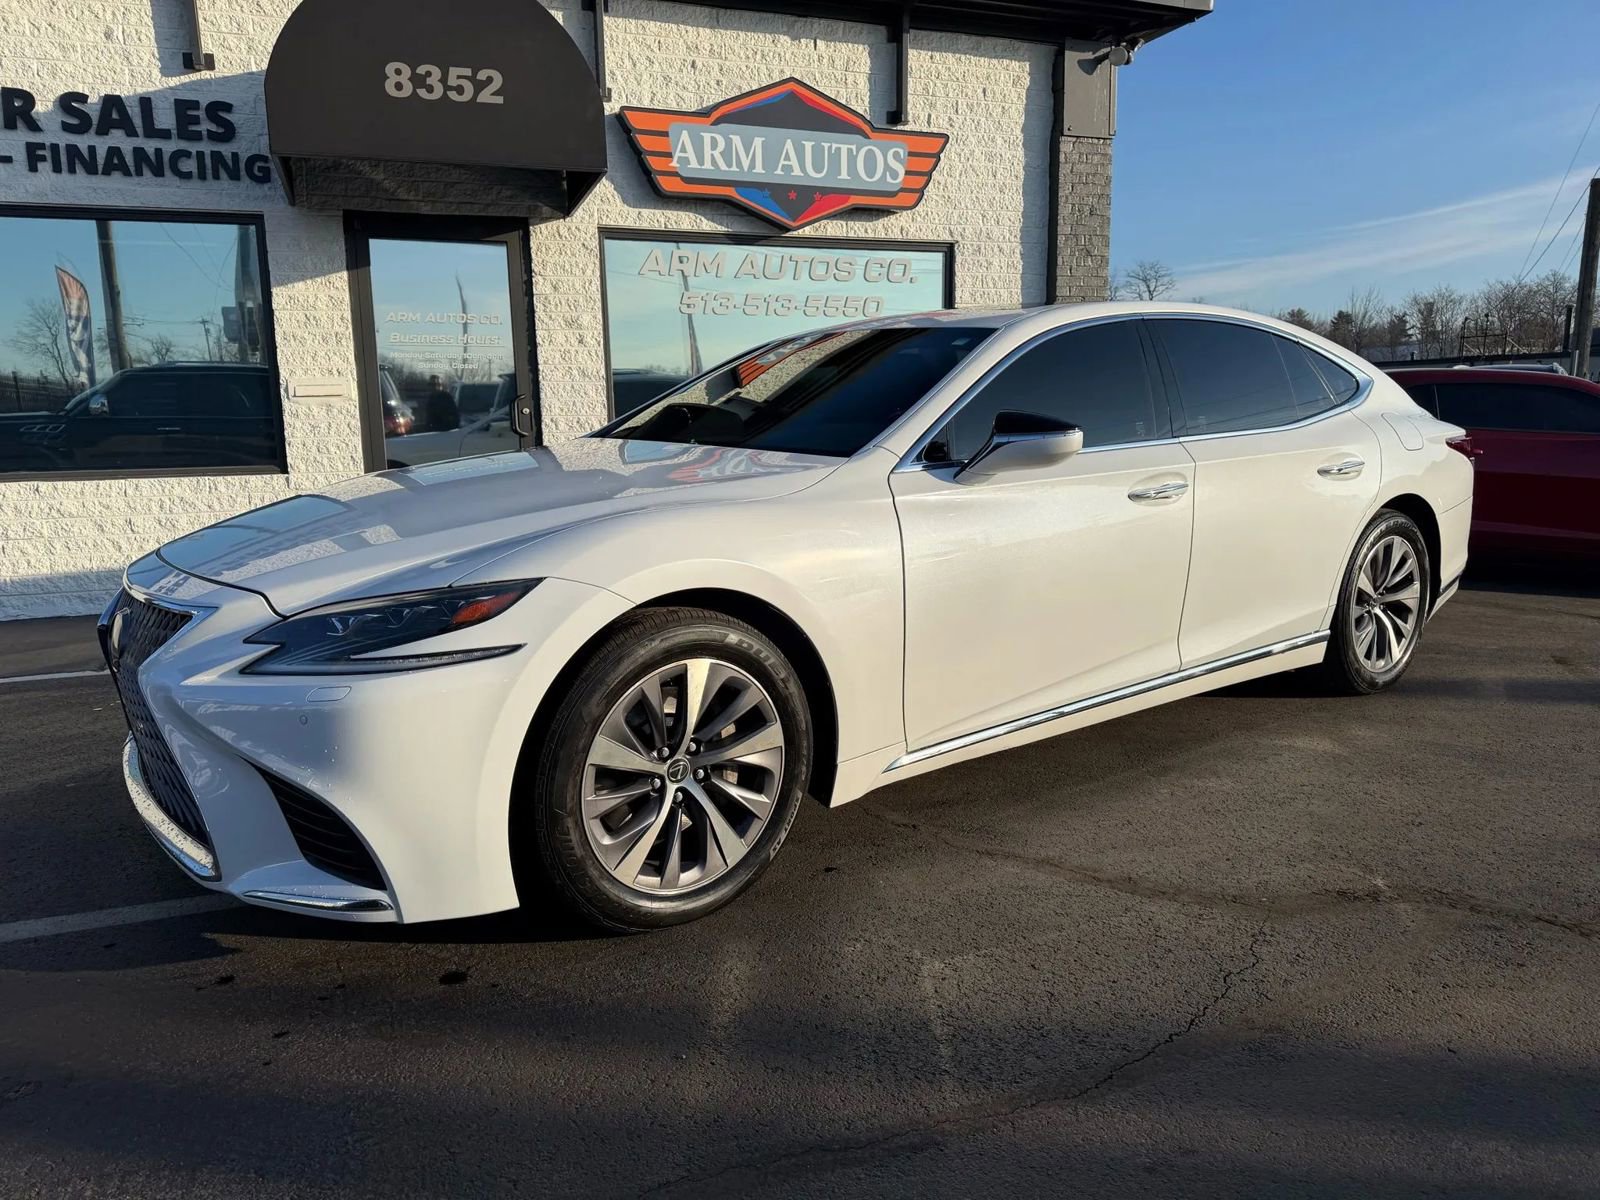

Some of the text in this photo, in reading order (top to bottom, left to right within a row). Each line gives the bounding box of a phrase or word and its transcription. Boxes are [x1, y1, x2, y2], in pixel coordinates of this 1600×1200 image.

[384, 61, 504, 104] 8352
[57, 91, 237, 143] SALES
[25, 141, 272, 184] FINANCING
[669, 130, 906, 184] ARM AUTOS
[638, 249, 918, 284] ARM AUTOS CO.
[384, 311, 420, 323] ARM
[424, 312, 477, 324] AUTOS
[678, 291, 884, 318] 513-513-5550
[388, 332, 455, 345] Business
